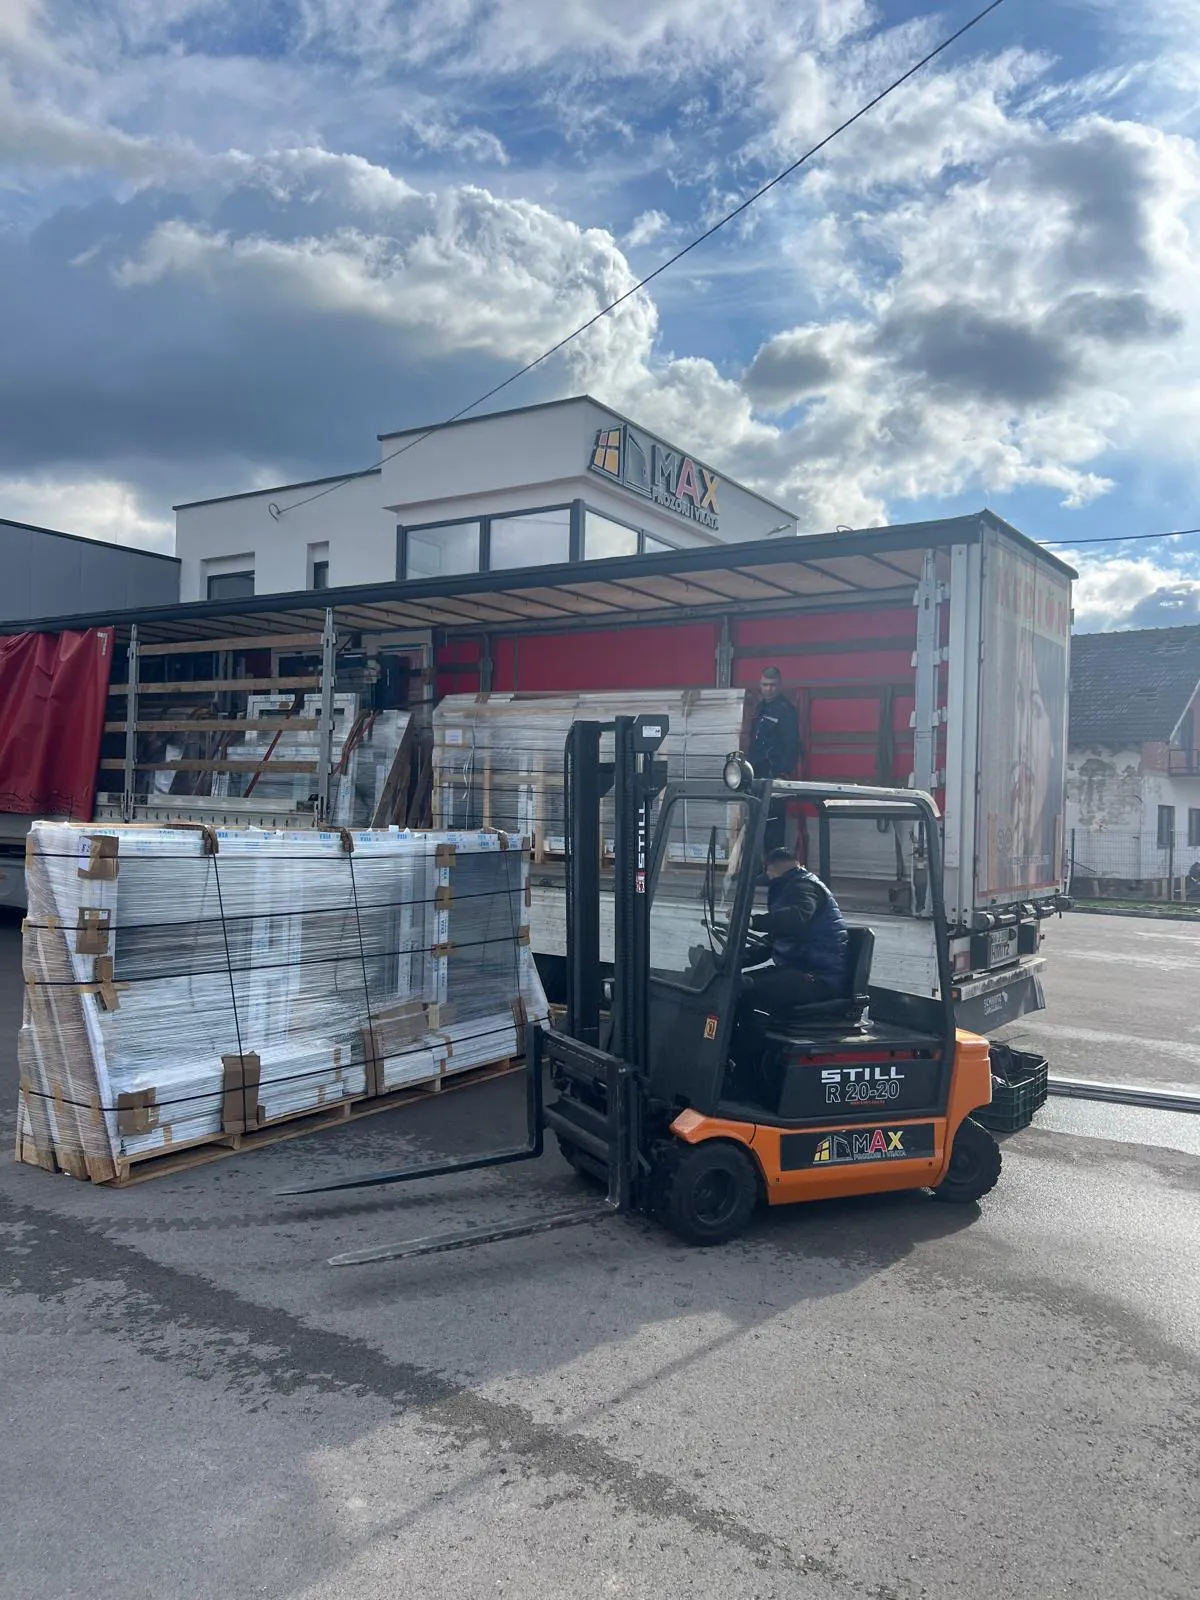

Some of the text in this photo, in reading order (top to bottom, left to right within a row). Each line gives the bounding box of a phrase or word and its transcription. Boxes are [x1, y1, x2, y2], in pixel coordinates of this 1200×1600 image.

[652, 444, 720, 513] MAX
[638, 801, 646, 868] STILL
[821, 1066, 905, 1084] STILL
[825, 1080, 900, 1103] R 20-20
[853, 1130, 904, 1153] MAX
